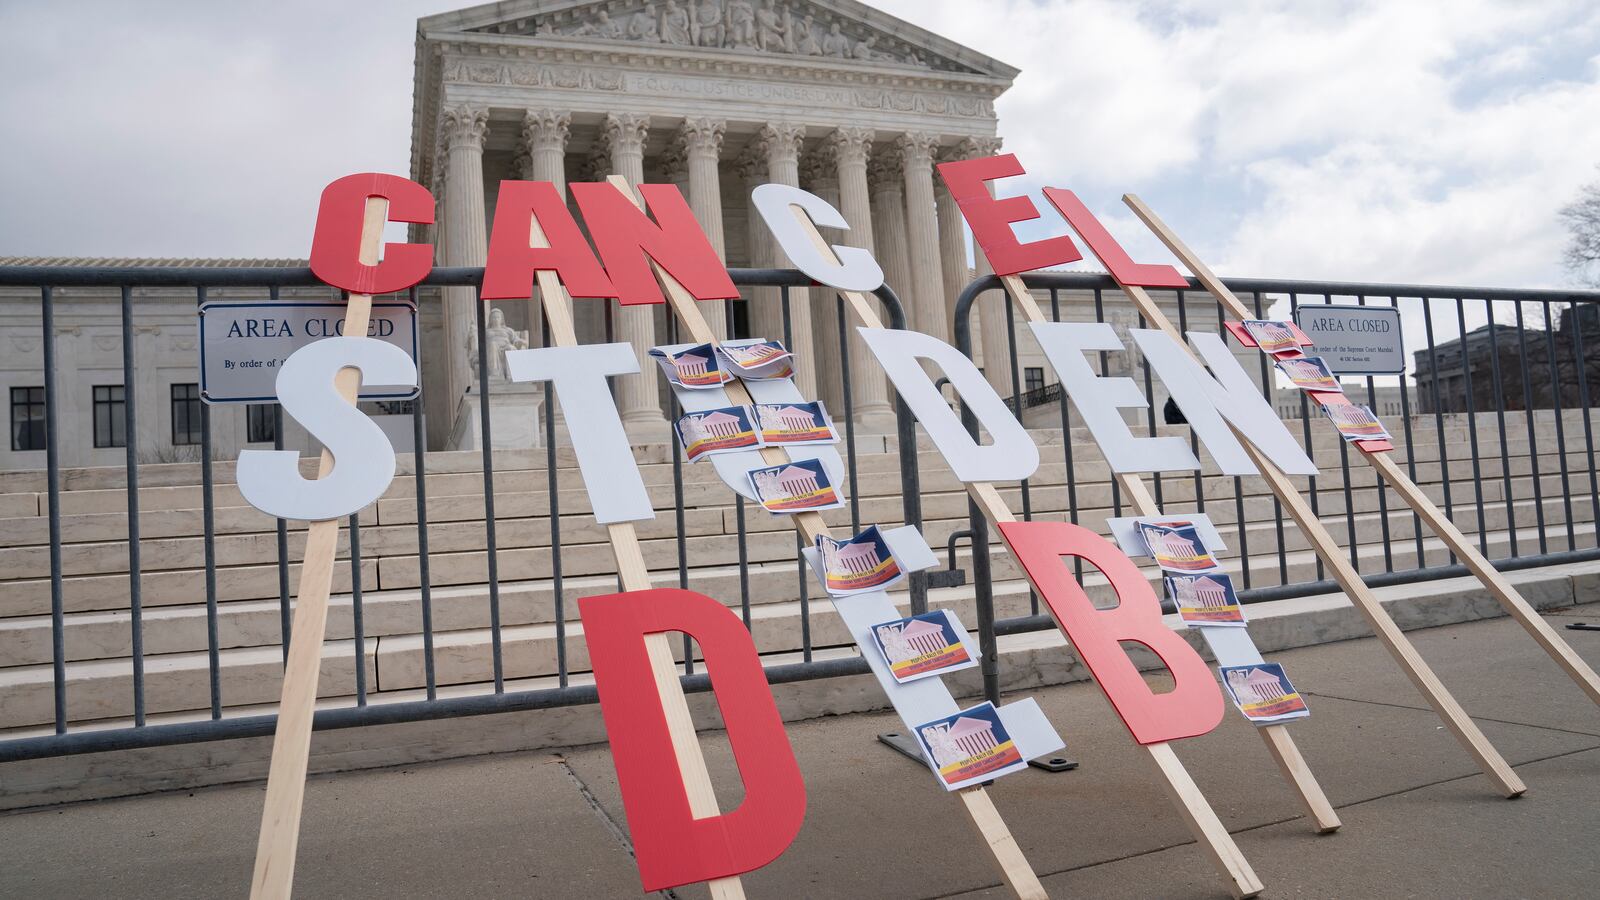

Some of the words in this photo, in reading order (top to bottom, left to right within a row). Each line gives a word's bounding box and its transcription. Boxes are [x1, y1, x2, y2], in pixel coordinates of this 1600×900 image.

[636, 78, 691, 92] EQUAL
[698, 81, 754, 97] JUSTICE
[761, 85, 808, 100] UNDER
[817, 89, 844, 103] LAW
[310, 155, 1187, 306] CANCEL
[227, 319, 294, 338] AREA
[305, 318, 394, 338] CLOED
[1312, 318, 1344, 332] AREA
[1348, 318, 1390, 332] CLOSED
[224, 360, 236, 369] By
[240, 359, 262, 368] order
[267, 359, 276, 367] of
